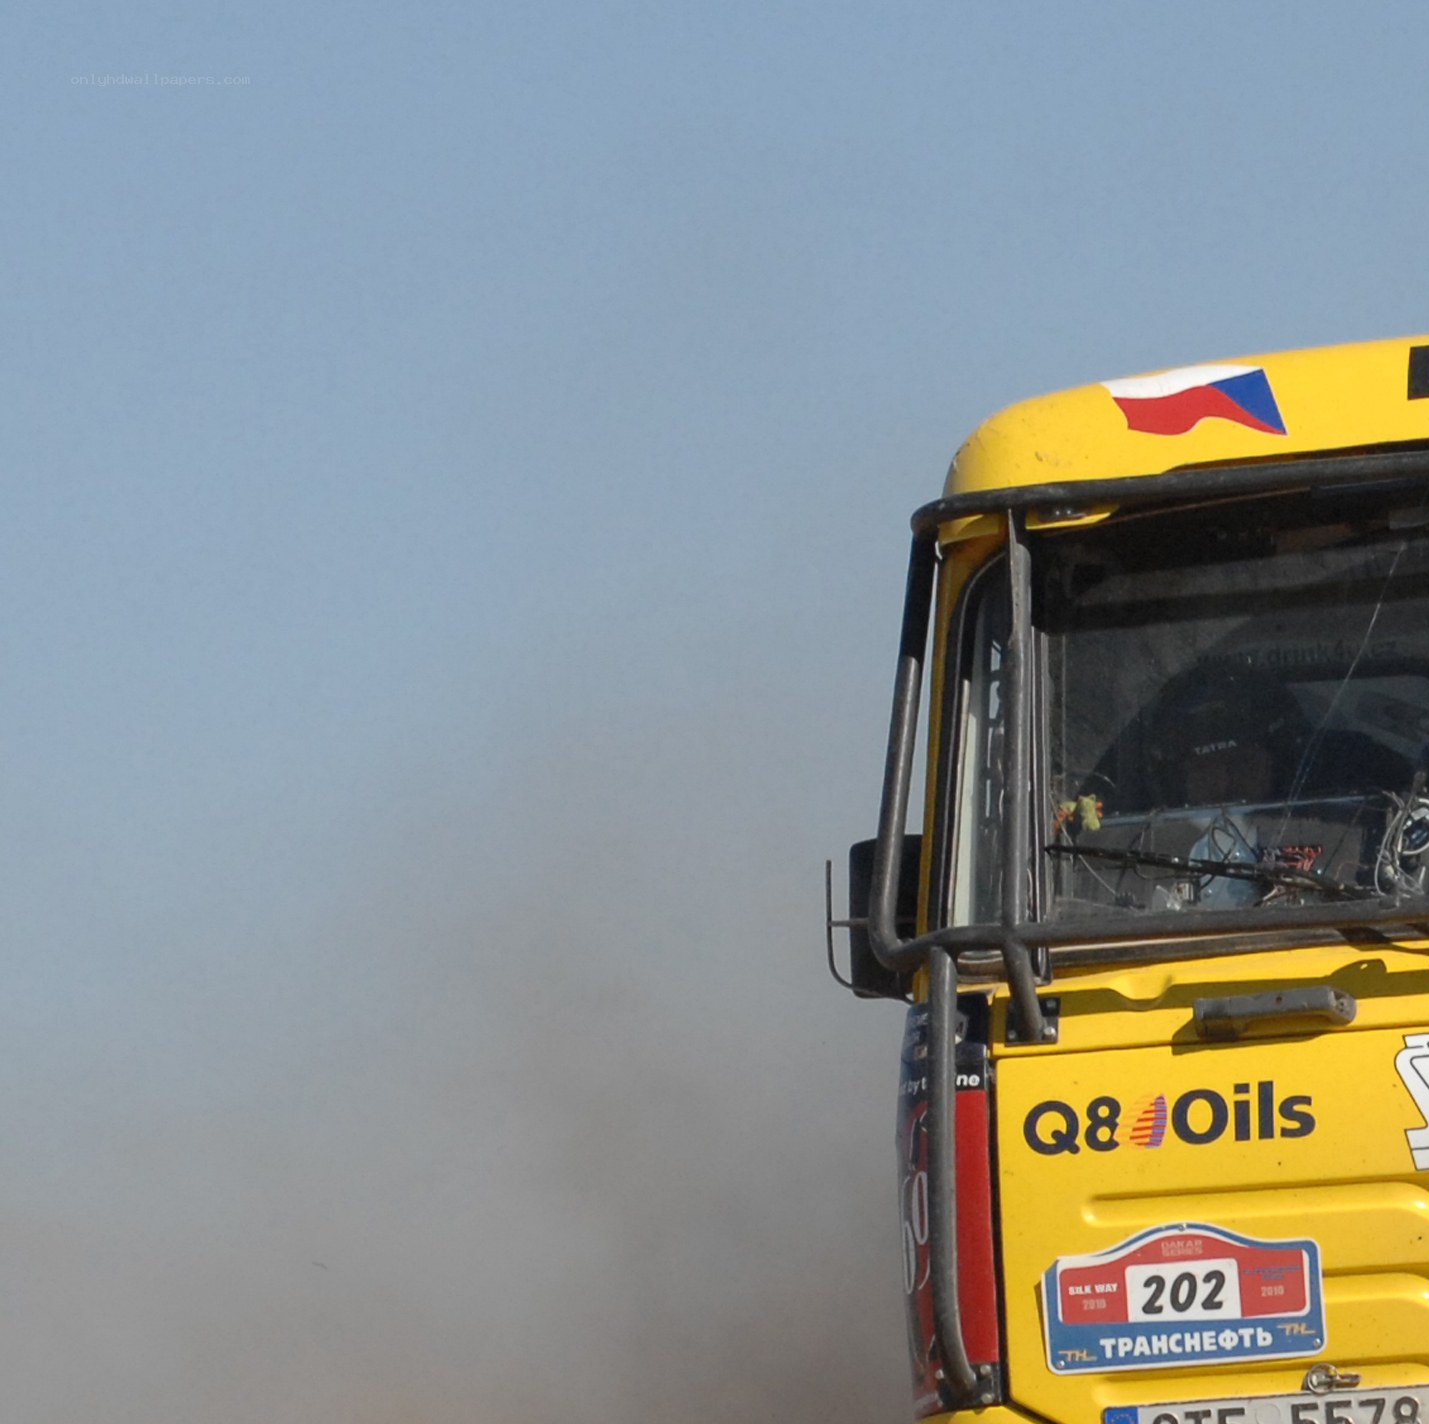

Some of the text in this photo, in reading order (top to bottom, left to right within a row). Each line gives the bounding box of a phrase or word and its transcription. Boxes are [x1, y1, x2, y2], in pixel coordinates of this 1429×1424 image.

[1022, 1080, 1316, 1156] Q8 Oils
[1160, 1239, 1203, 1249] DAKAR
[1068, 1283, 1118, 1296] SILK WAY
[1141, 1269, 1227, 1316] 202
[1260, 1286, 1285, 1297] 2010
[1082, 1299, 1107, 1311] 2010
[1100, 1327, 1273, 1359] ТРАНСНЕФТЬ
